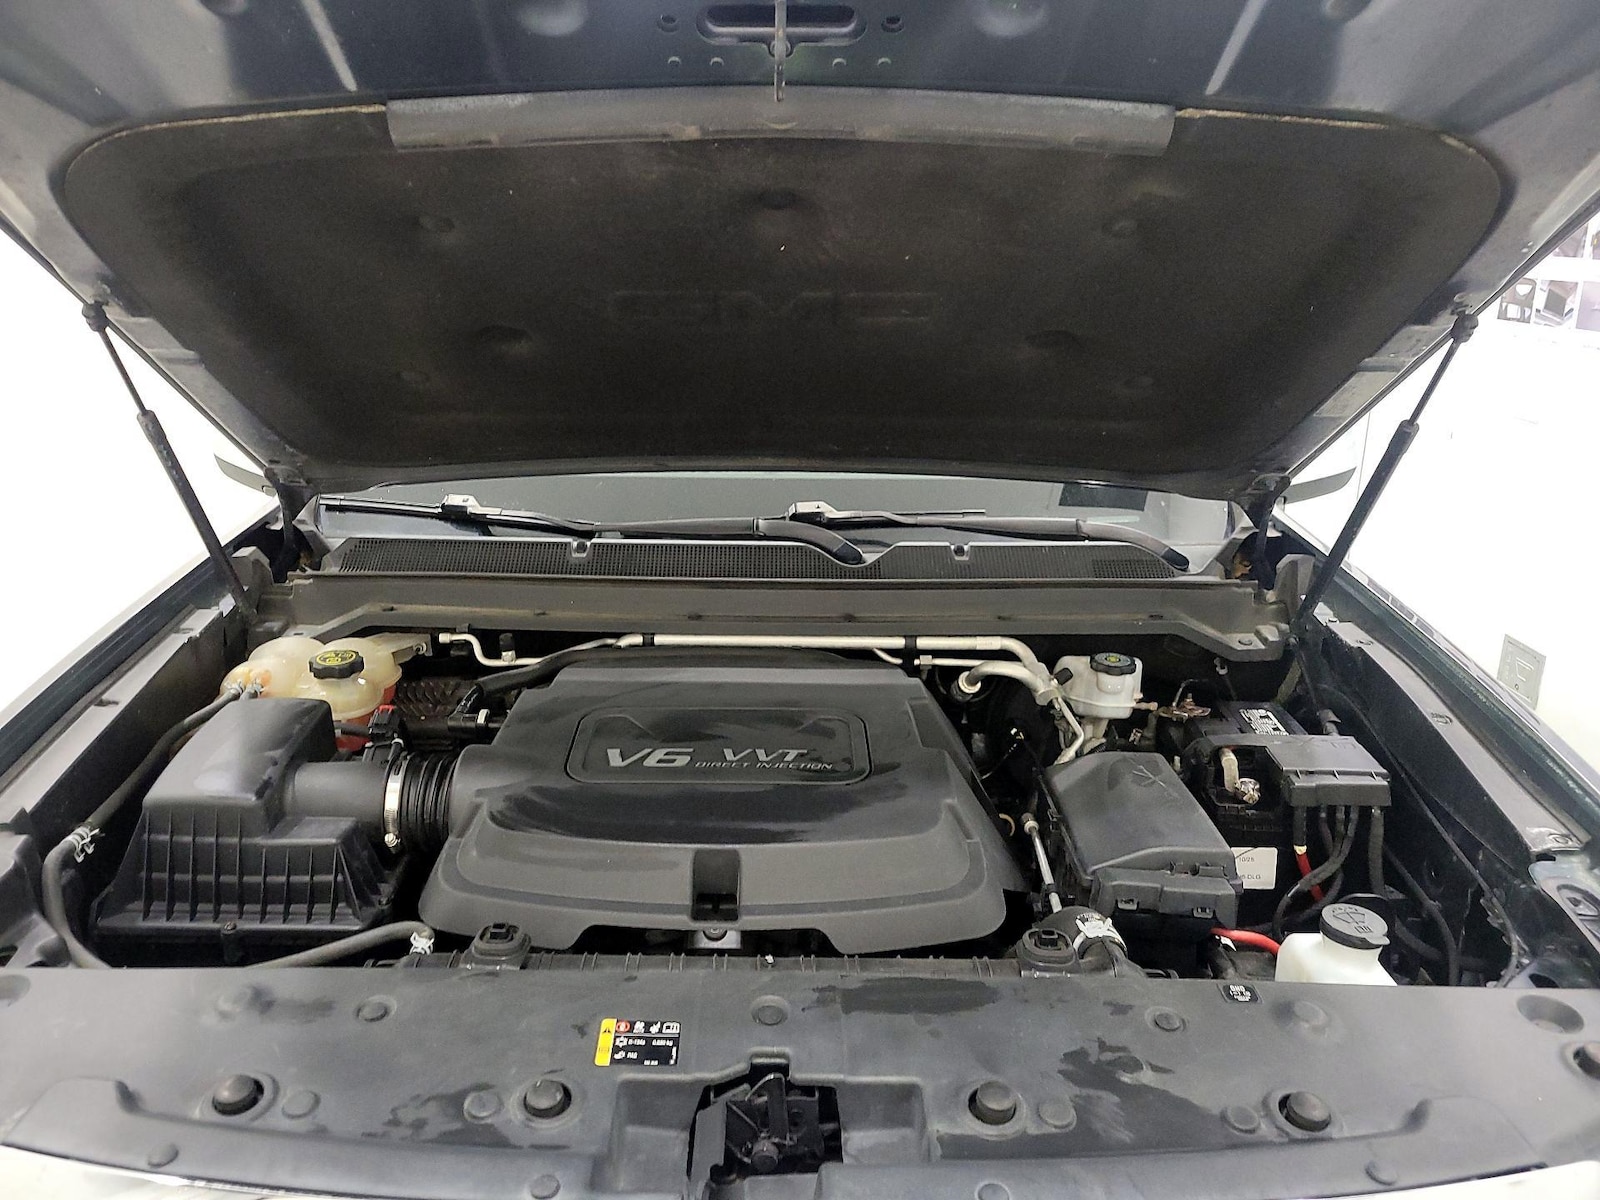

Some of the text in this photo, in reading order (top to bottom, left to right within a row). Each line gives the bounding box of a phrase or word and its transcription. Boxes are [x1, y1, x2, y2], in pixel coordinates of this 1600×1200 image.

[606, 748, 808, 768] V6 VVT
[755, 762, 834, 770] INJECTION
